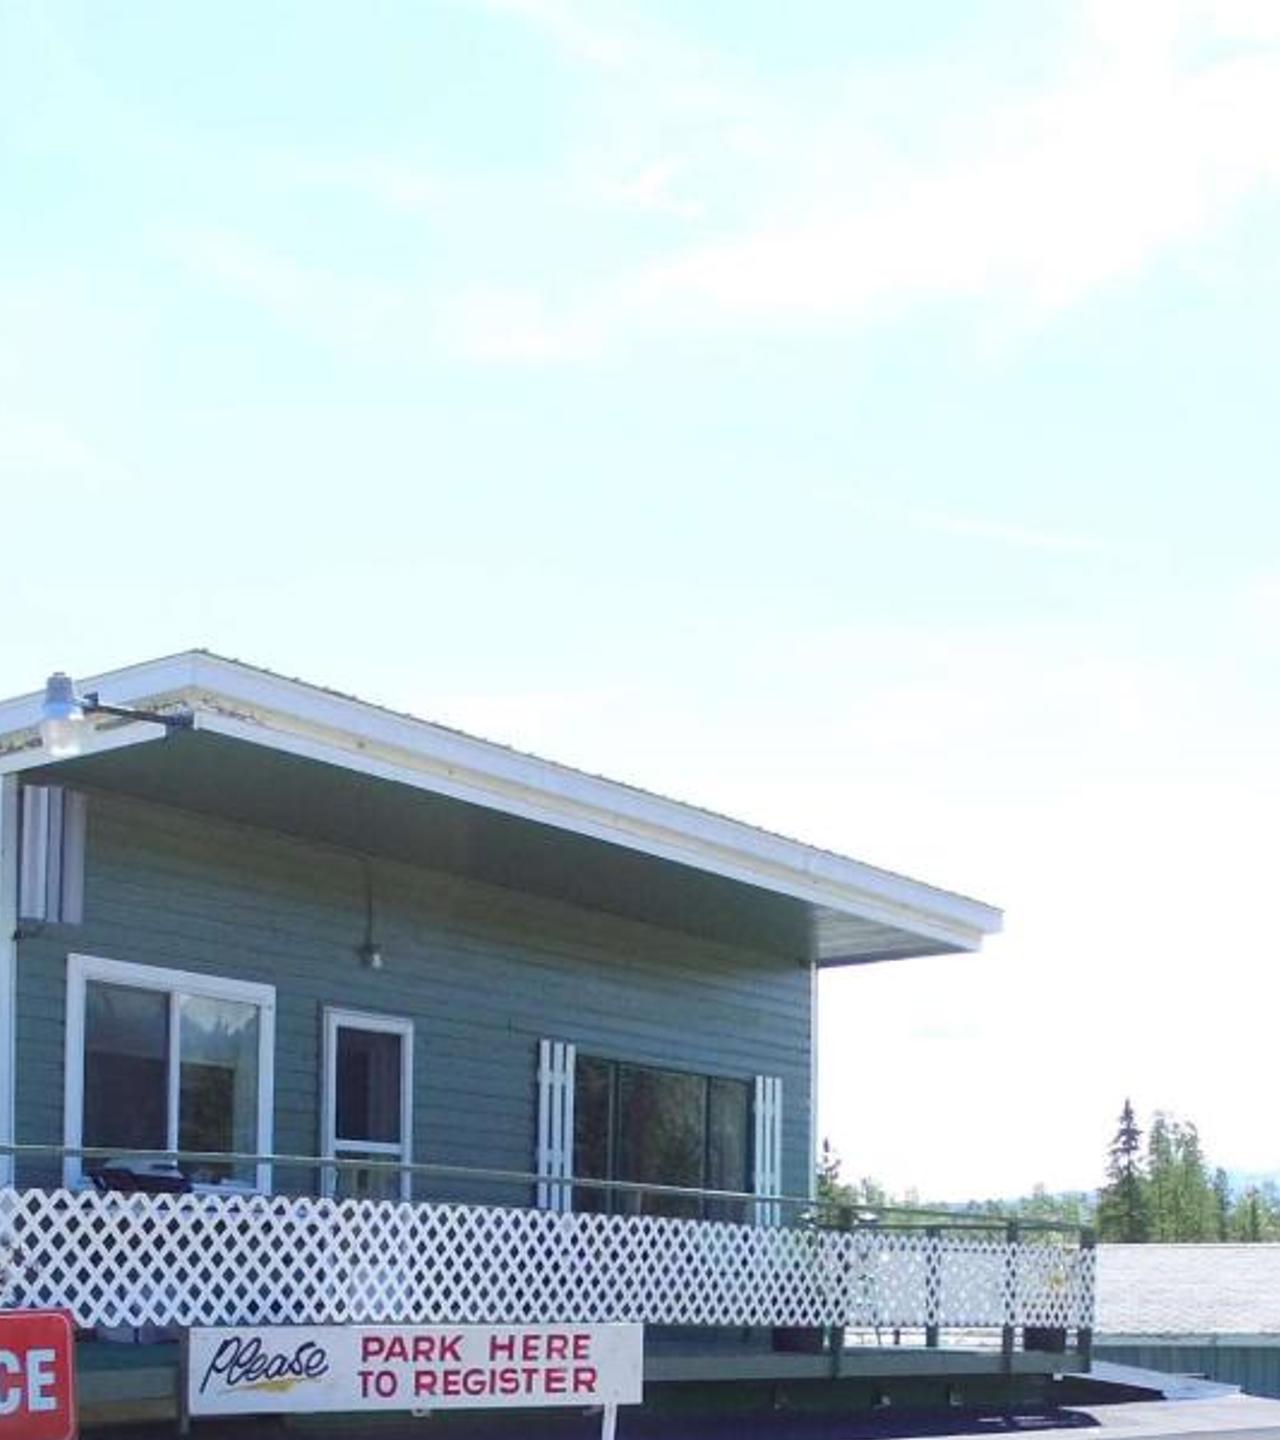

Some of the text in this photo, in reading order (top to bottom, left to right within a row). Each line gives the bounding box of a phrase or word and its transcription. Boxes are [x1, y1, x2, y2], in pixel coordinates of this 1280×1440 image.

[361, 1334, 592, 1362] PARK HERE
[199, 1336, 329, 1394] Please
[357, 1367, 598, 1398] TO REGISTER
